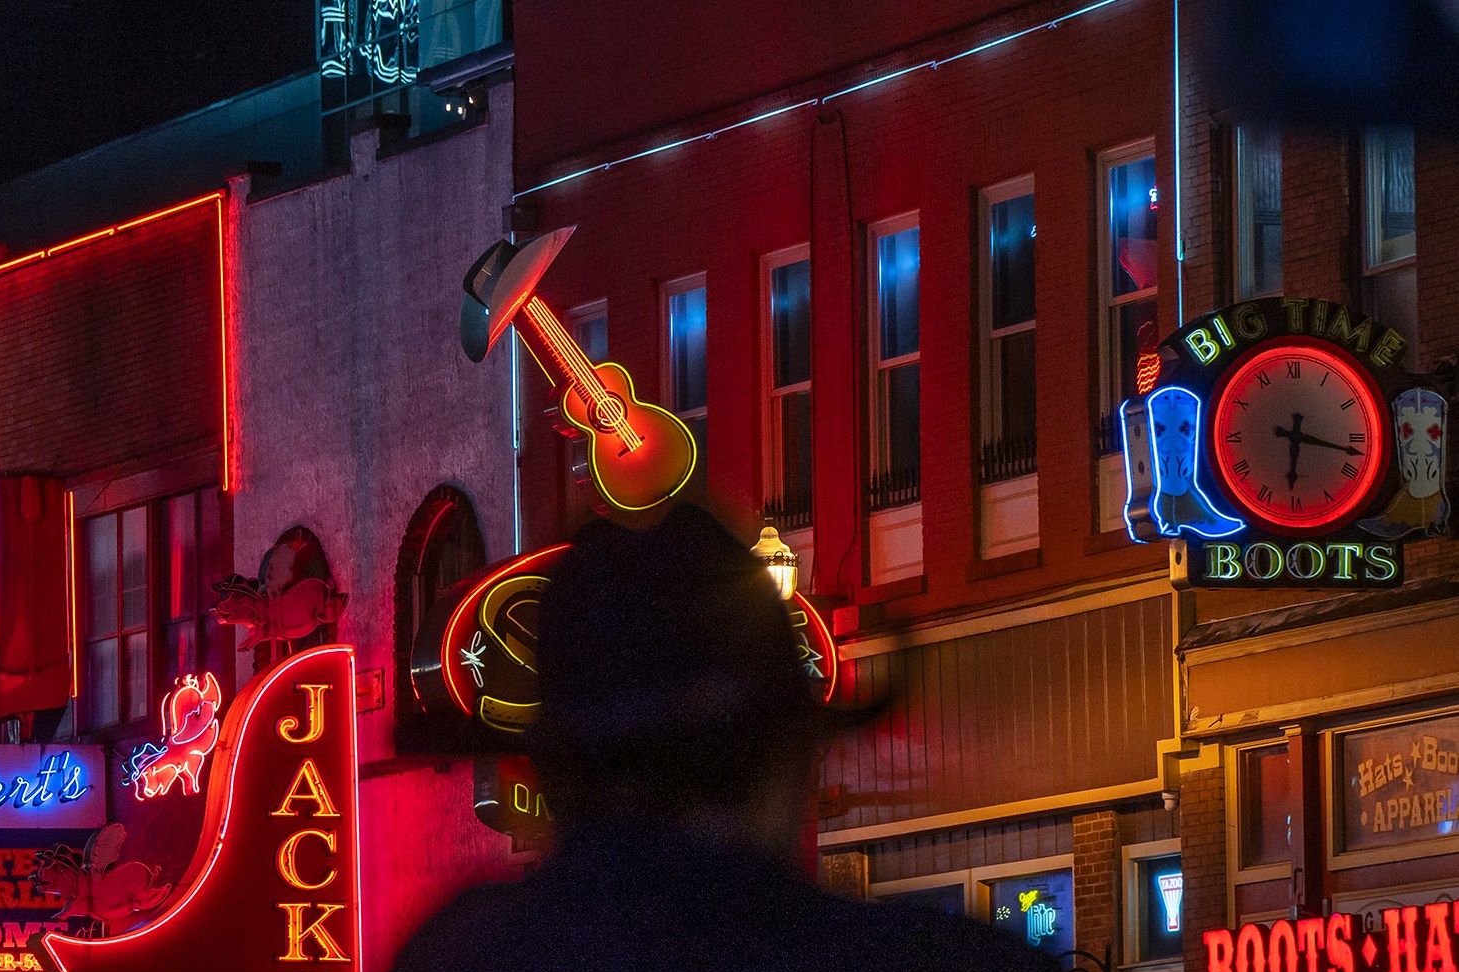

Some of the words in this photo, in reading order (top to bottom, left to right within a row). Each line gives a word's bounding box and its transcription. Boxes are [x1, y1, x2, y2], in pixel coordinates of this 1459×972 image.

[1184, 303, 1268, 366] BIG
[1284, 297, 1407, 367] TIME
[1203, 542, 1397, 580] BOOTS
[1357, 753, 1404, 798] Hats
[1422, 735, 1459, 775] Boo
[1373, 788, 1459, 833] APPAREL
[1160, 878, 1182, 889] YAZOO
[1027, 903, 1056, 946] Lite
